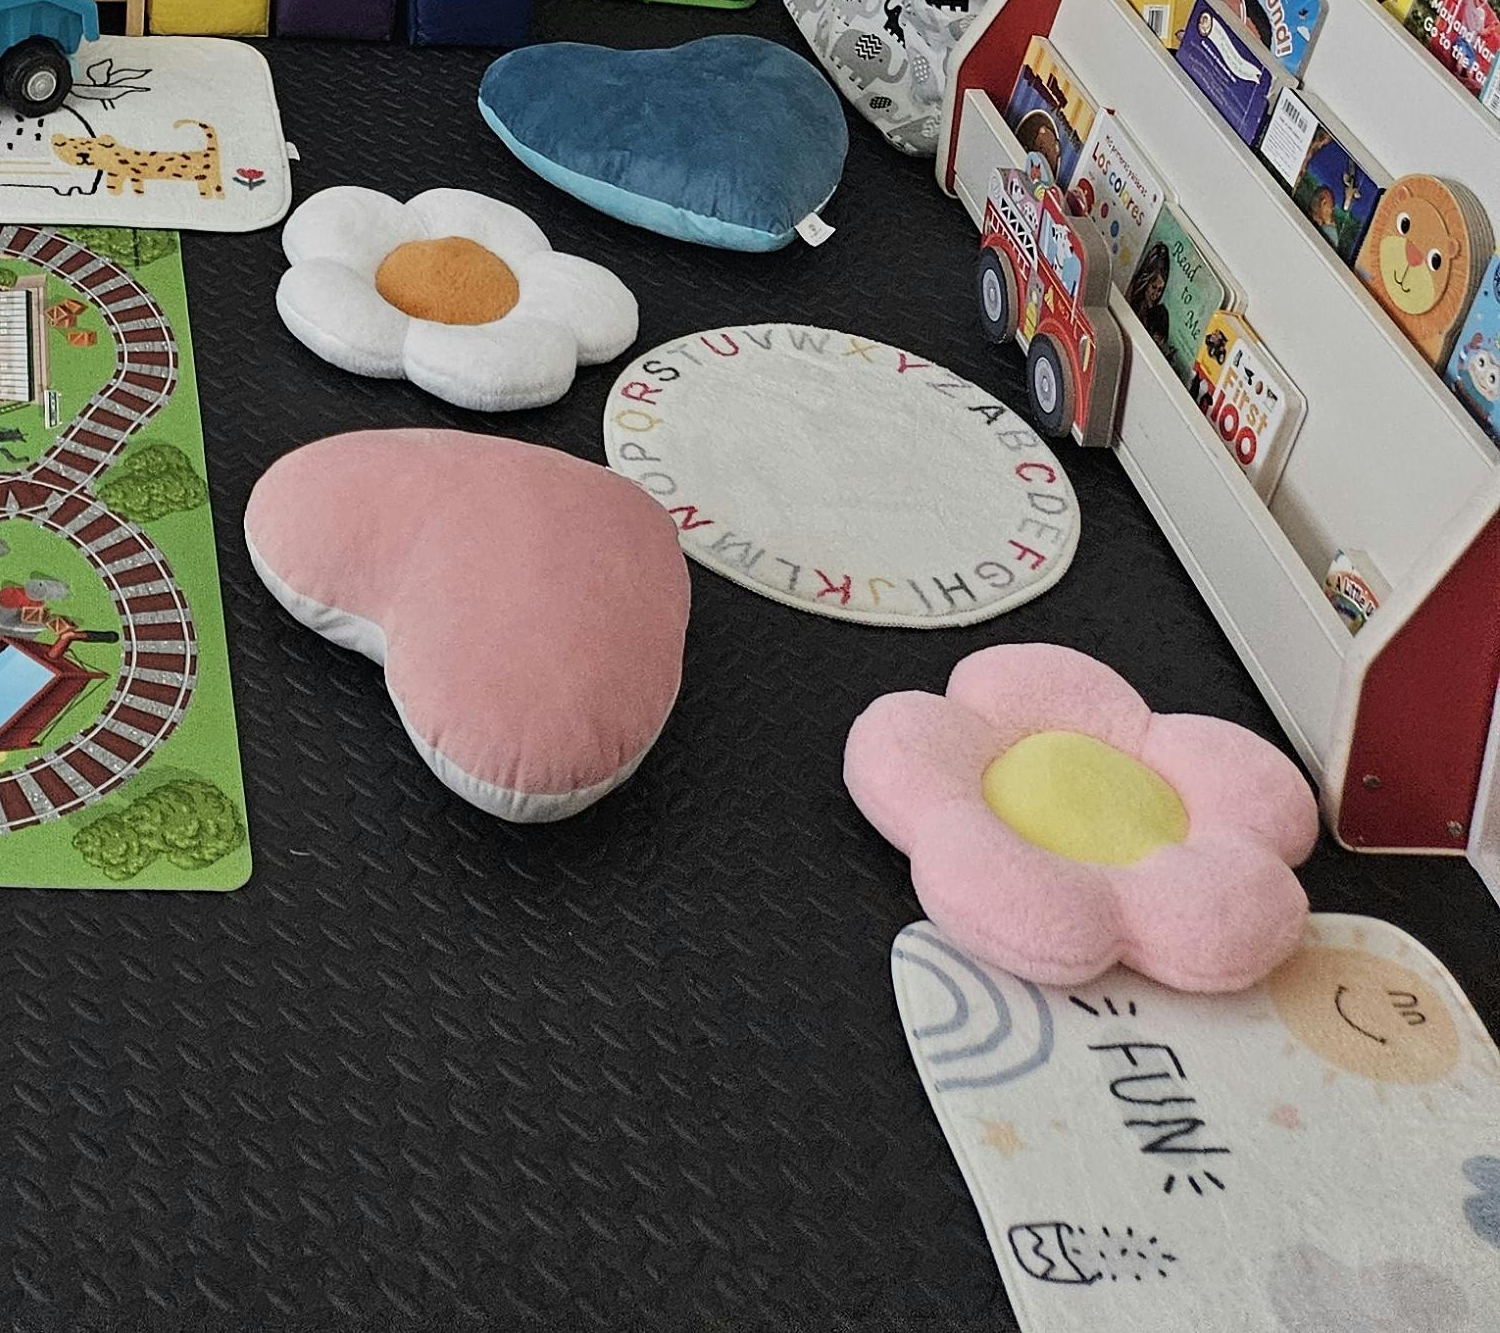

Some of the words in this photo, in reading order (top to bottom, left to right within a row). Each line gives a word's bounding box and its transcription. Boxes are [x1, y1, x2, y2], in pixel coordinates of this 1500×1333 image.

[1423, 16, 1438, 38] Go
[1439, 32, 1451, 50] to
[1451, 44, 1470, 68] the
[1453, 20, 1474, 42] and
[1108, 172, 1145, 227] colores
[1172, 240, 1202, 283] Read
[1181, 286, 1192, 305] to
[1185, 309, 1201, 341] Me
[1210, 388, 1257, 465] 100
[1222, 366, 1268, 436] First
[1088, 1042, 1231, 1154] FUN
